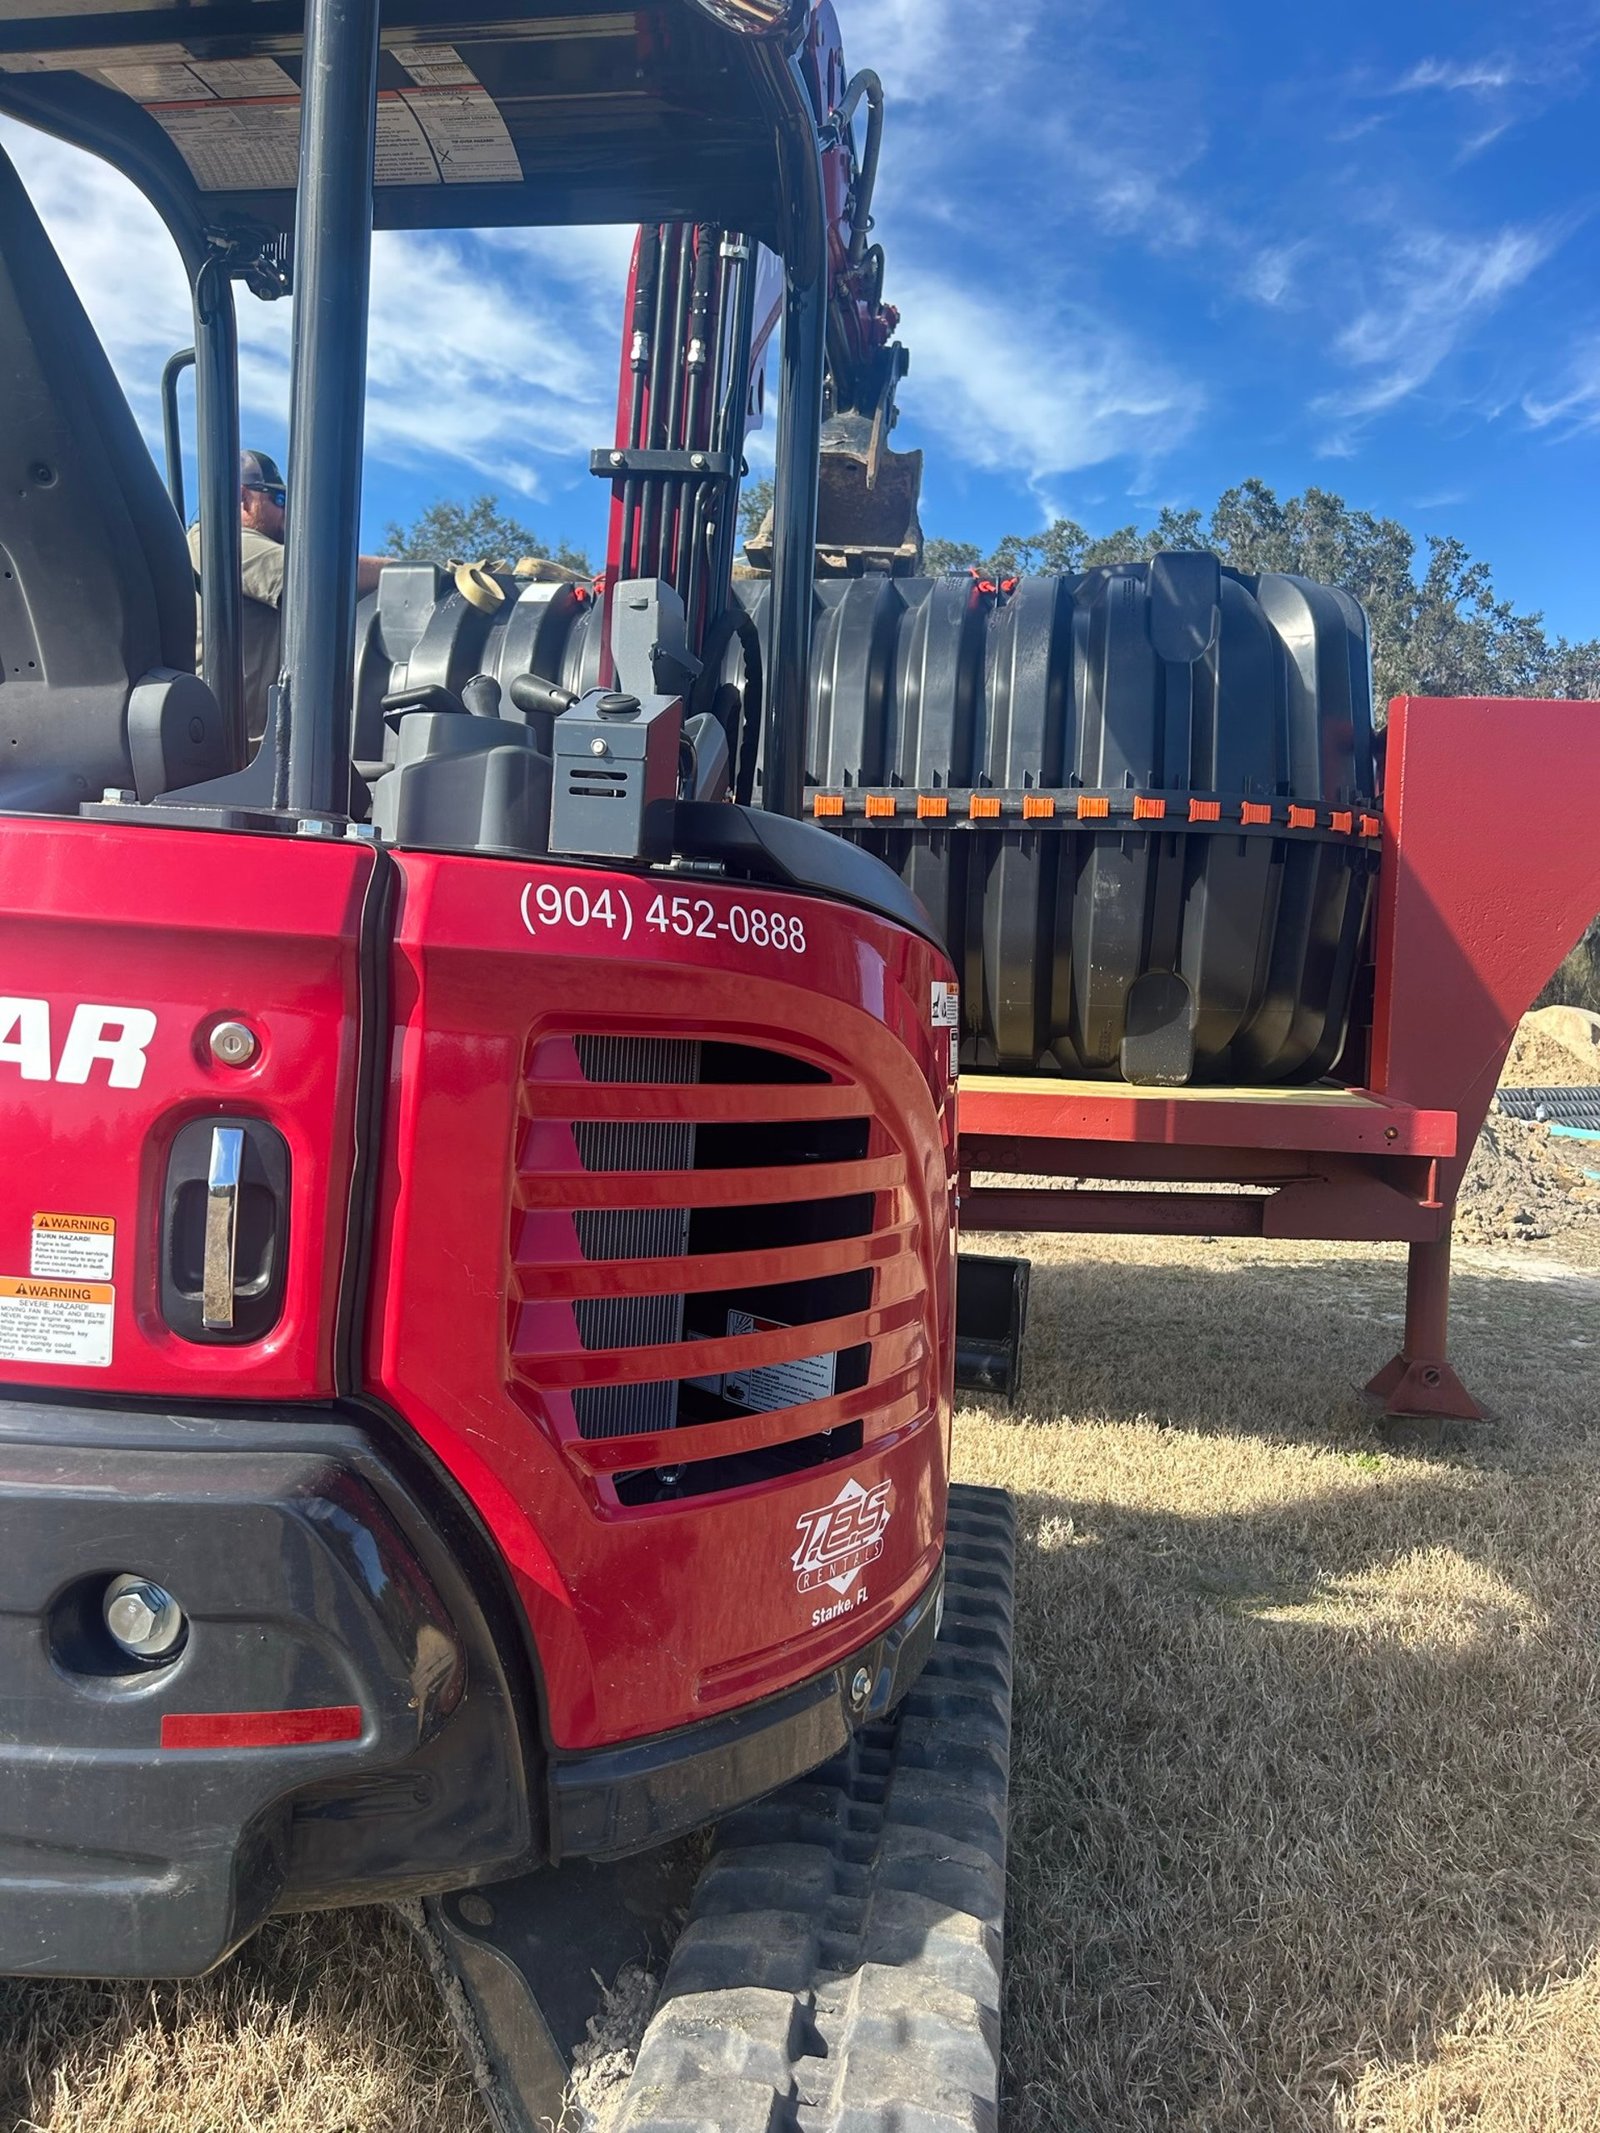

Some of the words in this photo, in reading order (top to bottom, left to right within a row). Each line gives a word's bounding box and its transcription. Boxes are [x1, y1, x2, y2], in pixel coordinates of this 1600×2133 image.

[520, 882, 633, 940] (904)
[645, 894, 806, 953] 452-0888
[51, 1218, 110, 1232] WARNING
[29, 1286, 91, 1300] WARNING
[19, 1299, 50, 1307] SEVERE
[53, 1302, 89, 1310] HAZARD!
[84, 1311, 106, 1319] BELTS!
[803, 1541, 880, 1589] RENTALS
[812, 1597, 854, 1627] Starke,
[856, 1586, 868, 1606] FL
